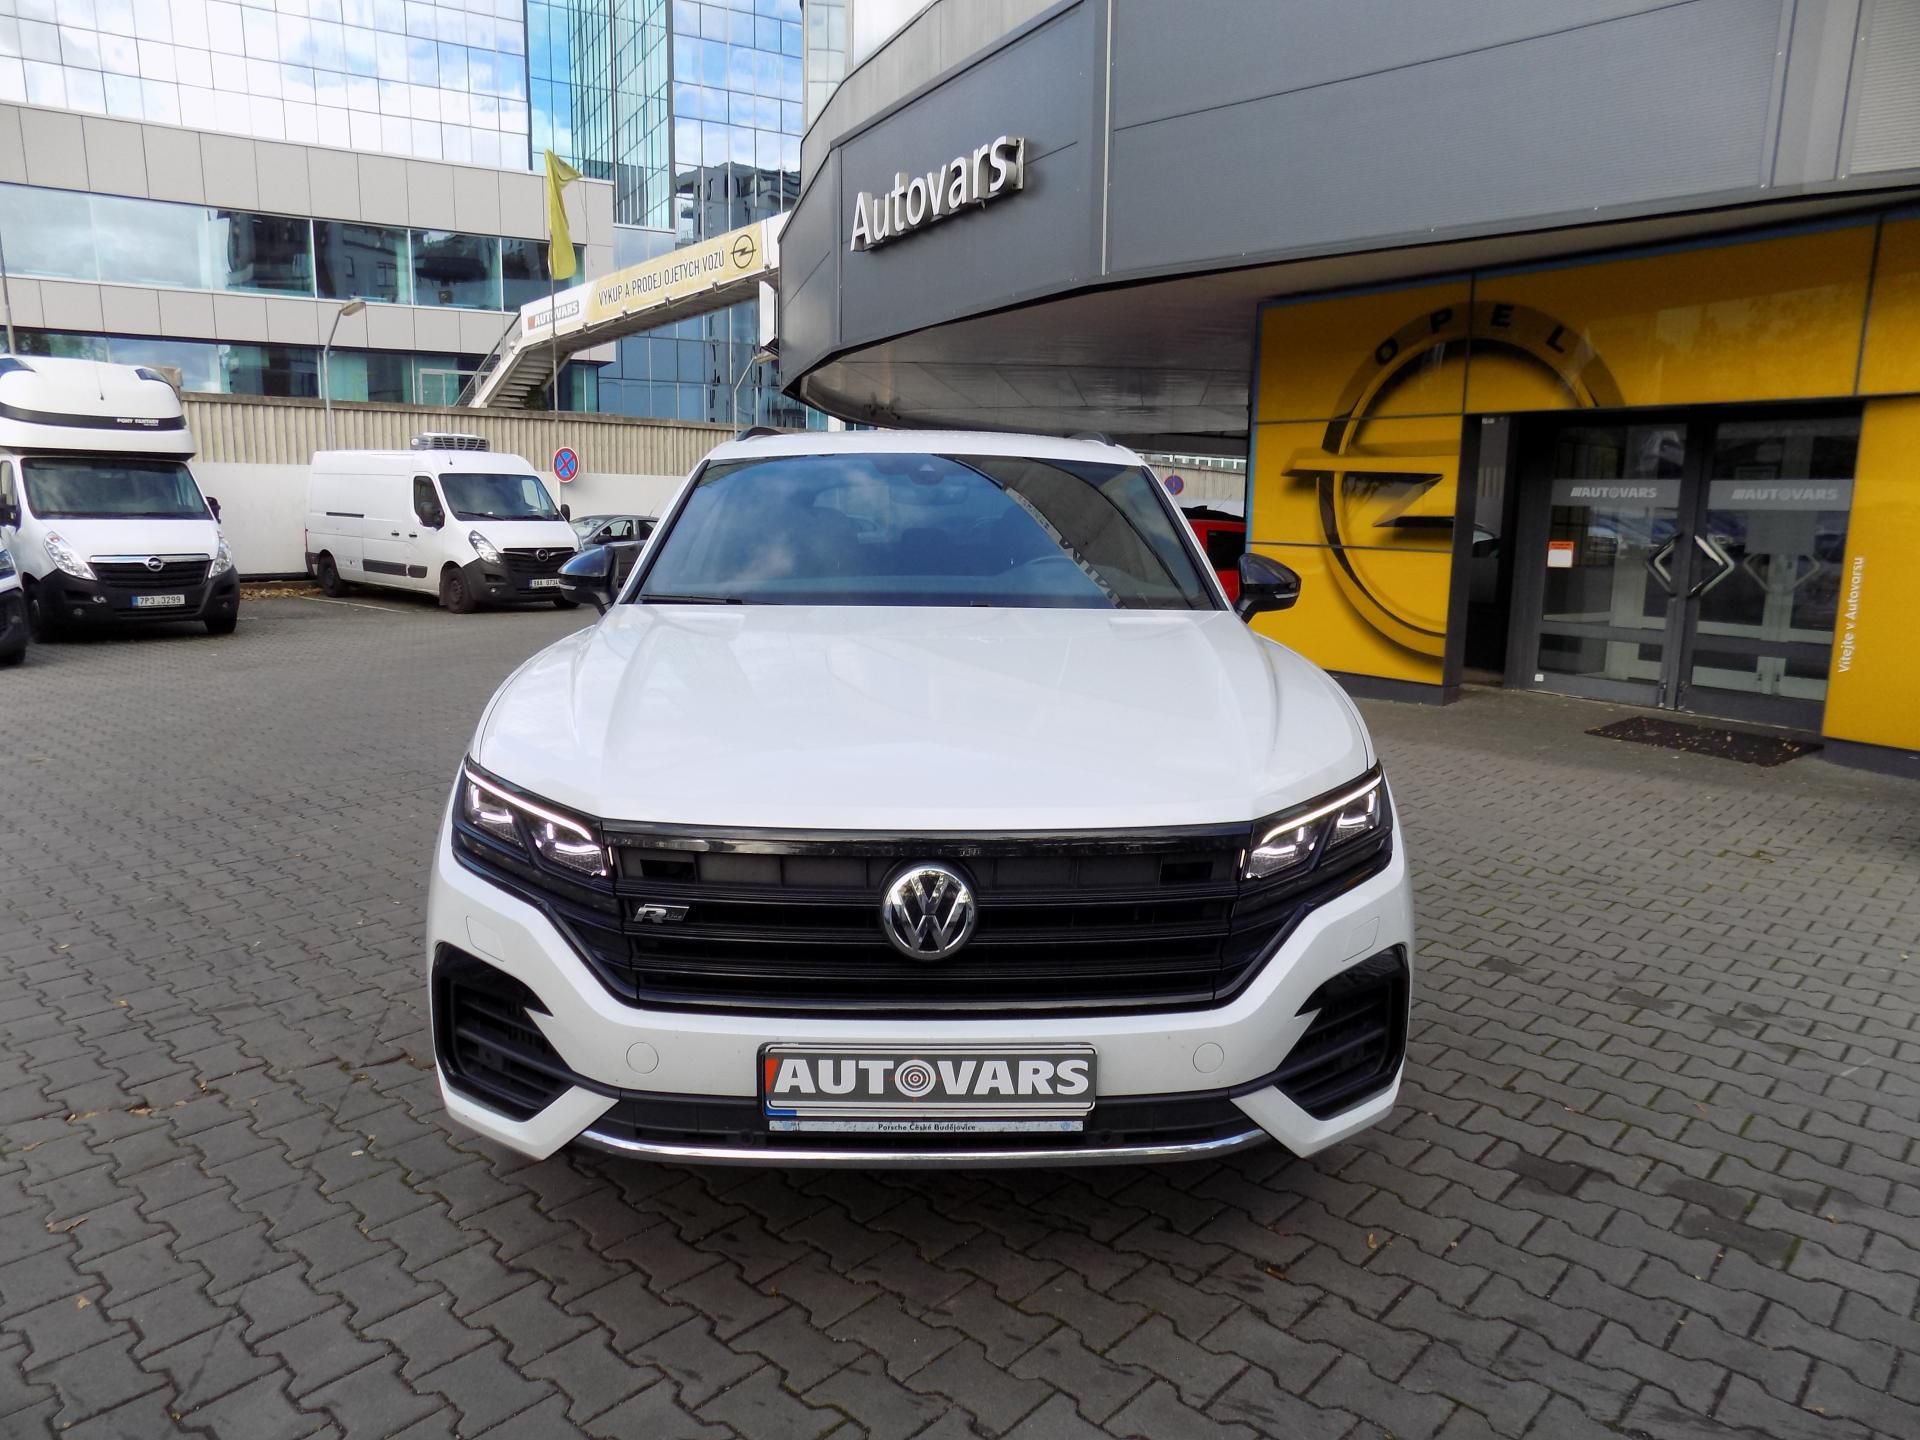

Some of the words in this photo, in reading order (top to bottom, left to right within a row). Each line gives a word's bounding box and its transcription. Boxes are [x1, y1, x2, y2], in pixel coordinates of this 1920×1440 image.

[850, 136, 1010, 251] Autovars
[625, 282, 631, 298] A
[632, 271, 662, 297] PRODEJ
[1375, 303, 1566, 366] OPEL
[1579, 487, 1657, 499] AUTOVARS
[1744, 488, 1839, 500] AUTOVARS
[1845, 557, 1865, 620] Autovarsu
[1845, 623, 1856, 631] v
[774, 1059, 1089, 1098] AUTOVARS
[878, 1123, 907, 1131] Porsche
[910, 1121, 932, 1131] České
[934, 1123, 976, 1133] Budějovice
